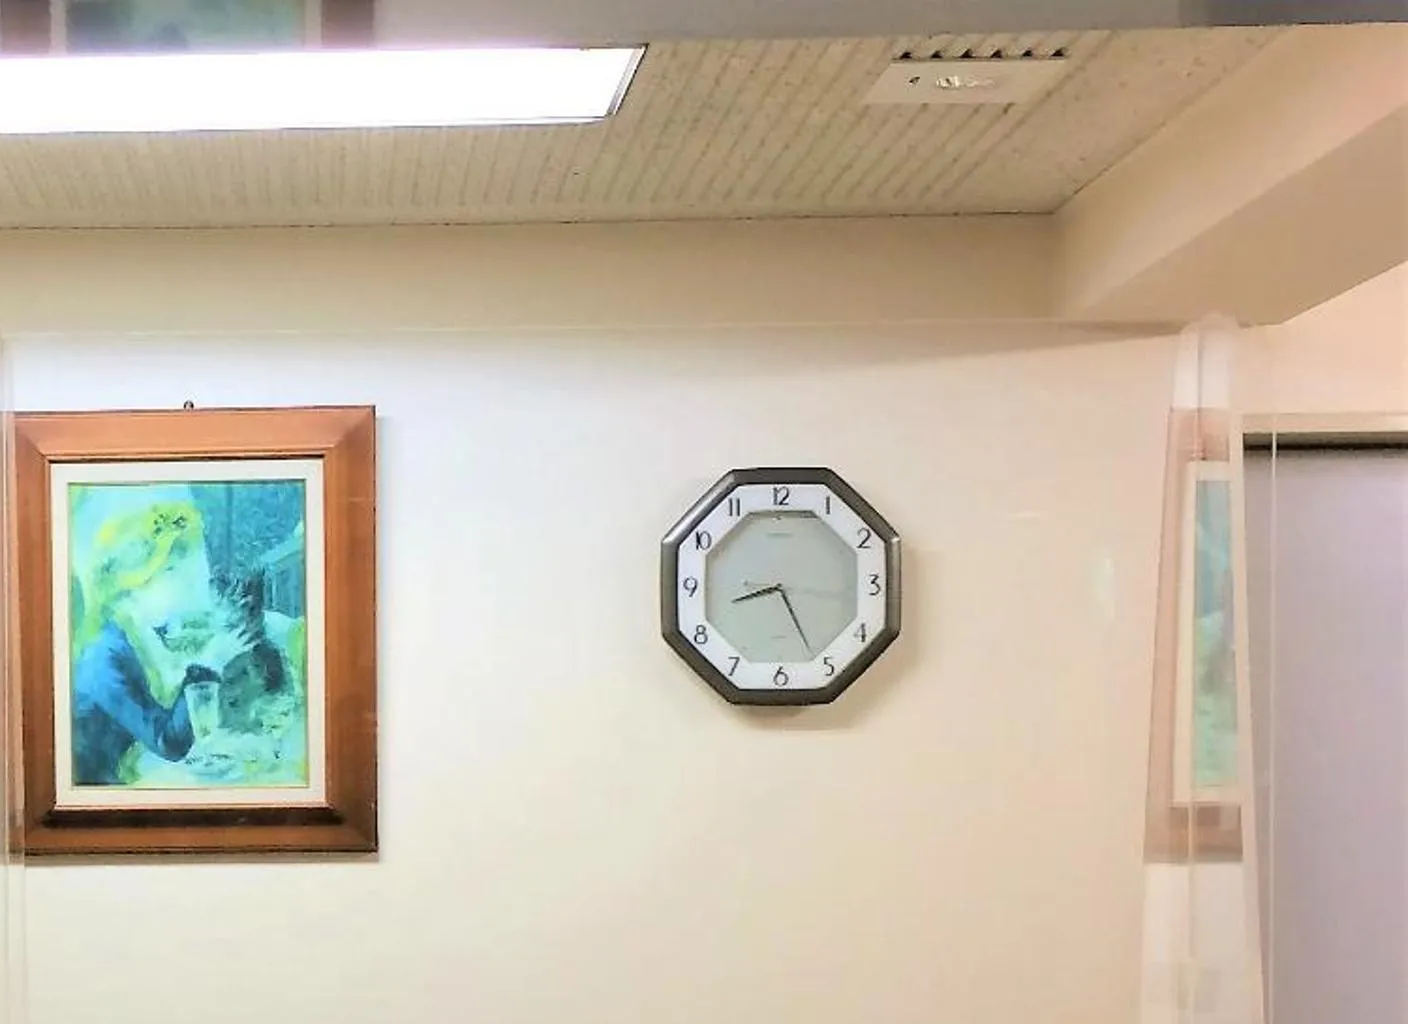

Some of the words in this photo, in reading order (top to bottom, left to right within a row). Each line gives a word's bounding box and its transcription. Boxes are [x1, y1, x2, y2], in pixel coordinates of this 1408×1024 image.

[772, 486, 790, 506] 12
[728, 497, 741, 517] 11
[694, 530, 712, 550] 10
[856, 528, 872, 549] 2
[682, 577, 698, 598] 9
[868, 574, 881, 597] 3
[693, 624, 708, 645] 8
[853, 623, 867, 643] 4
[727, 656, 741, 677] 7
[773, 666, 789, 687] 6
[822, 656, 835, 677] 5
